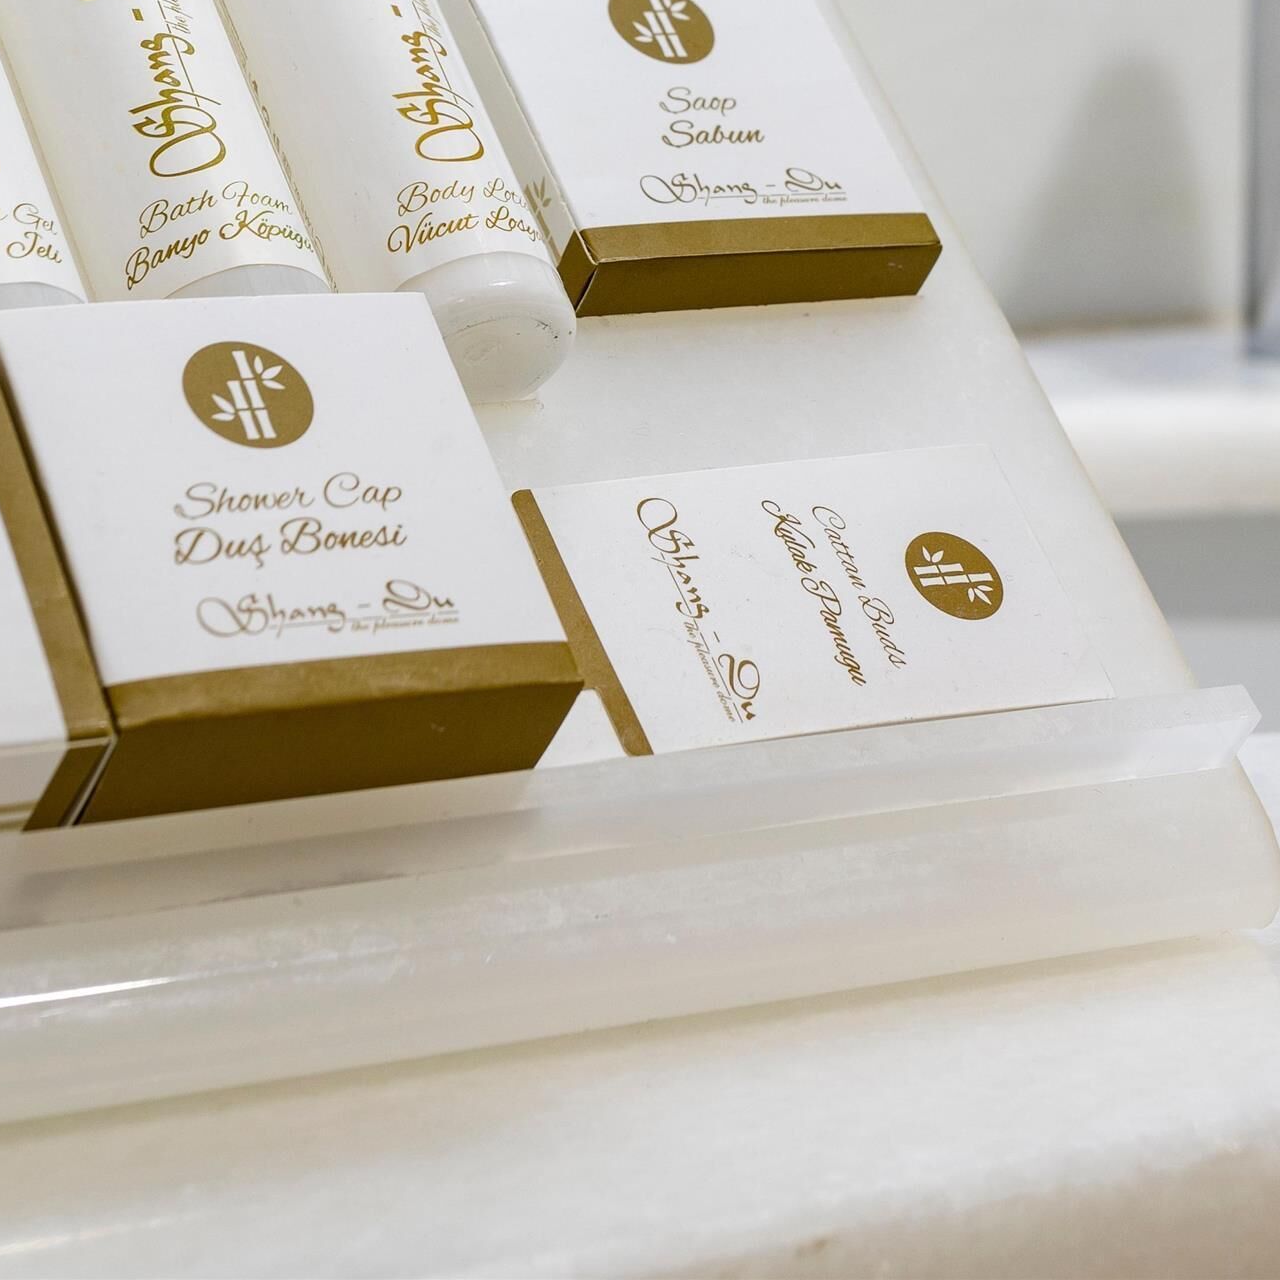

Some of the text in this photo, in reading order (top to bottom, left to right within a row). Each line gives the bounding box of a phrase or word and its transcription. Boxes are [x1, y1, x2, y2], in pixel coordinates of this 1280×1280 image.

[661, 120, 765, 148] Sabun
[12, 203, 57, 235] Gel
[139, 181, 293, 239] Bath Foam
[397, 180, 475, 217] Body
[387, 212, 479, 253] Vücut
[125, 228, 211, 290] Banyo
[174, 472, 403, 520] Shower Cap
[174, 517, 407, 568] Duş Bonesi
[761, 499, 818, 581] Kulak
[857, 595, 907, 670] Buds
